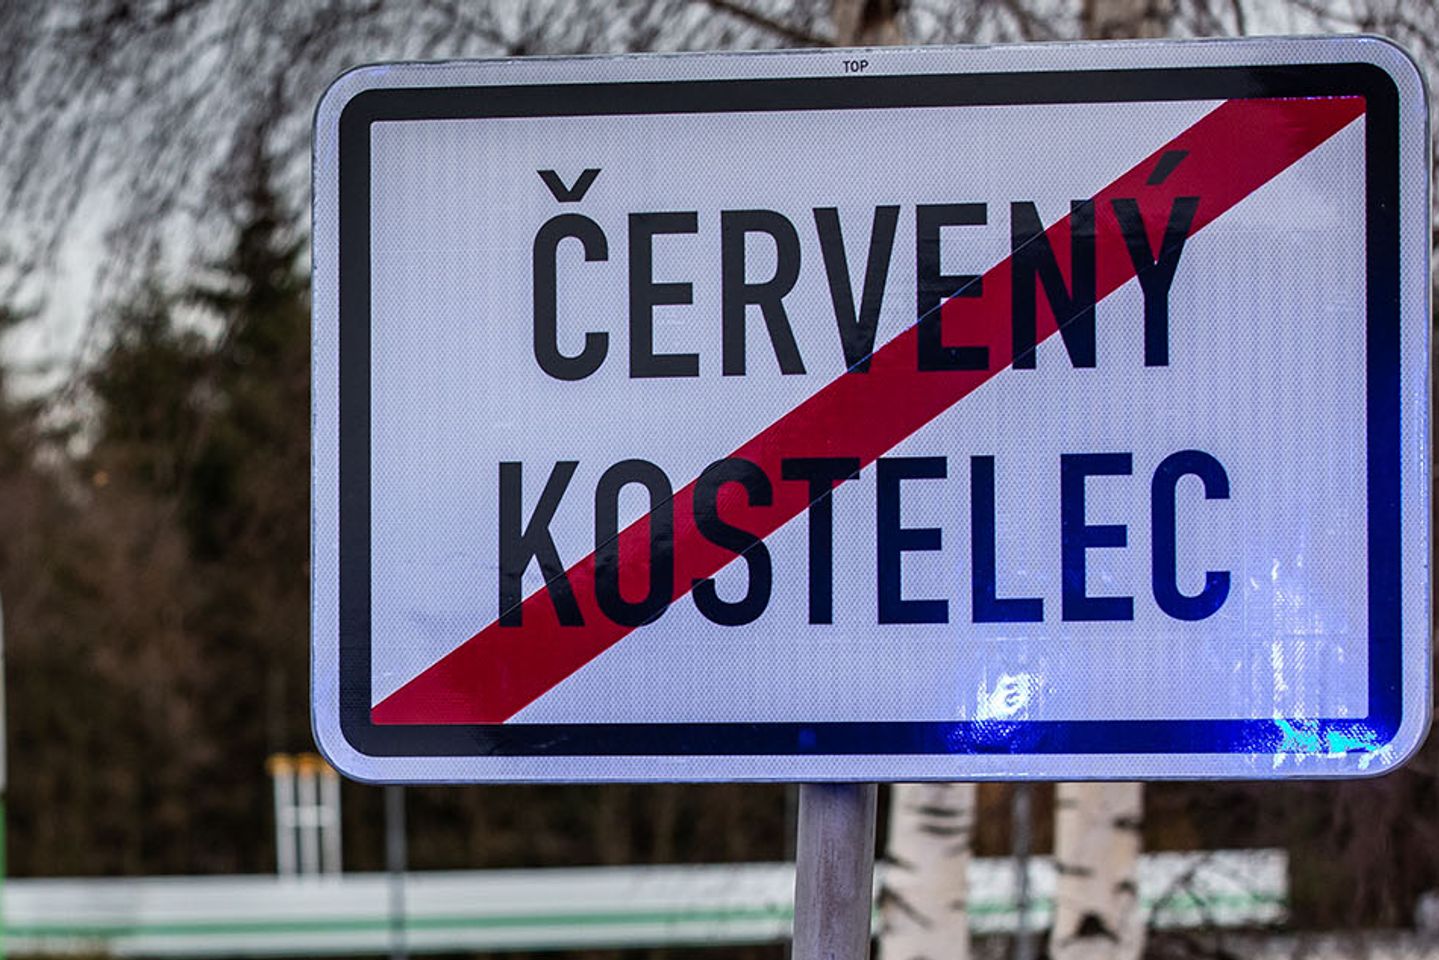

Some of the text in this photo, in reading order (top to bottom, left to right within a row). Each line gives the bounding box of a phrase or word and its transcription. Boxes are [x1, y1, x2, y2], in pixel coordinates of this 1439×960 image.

[842, 60, 869, 73] TOP
[532, 149, 1201, 382] ČERVENÝ
[497, 448, 1231, 629] KOSTELEC
